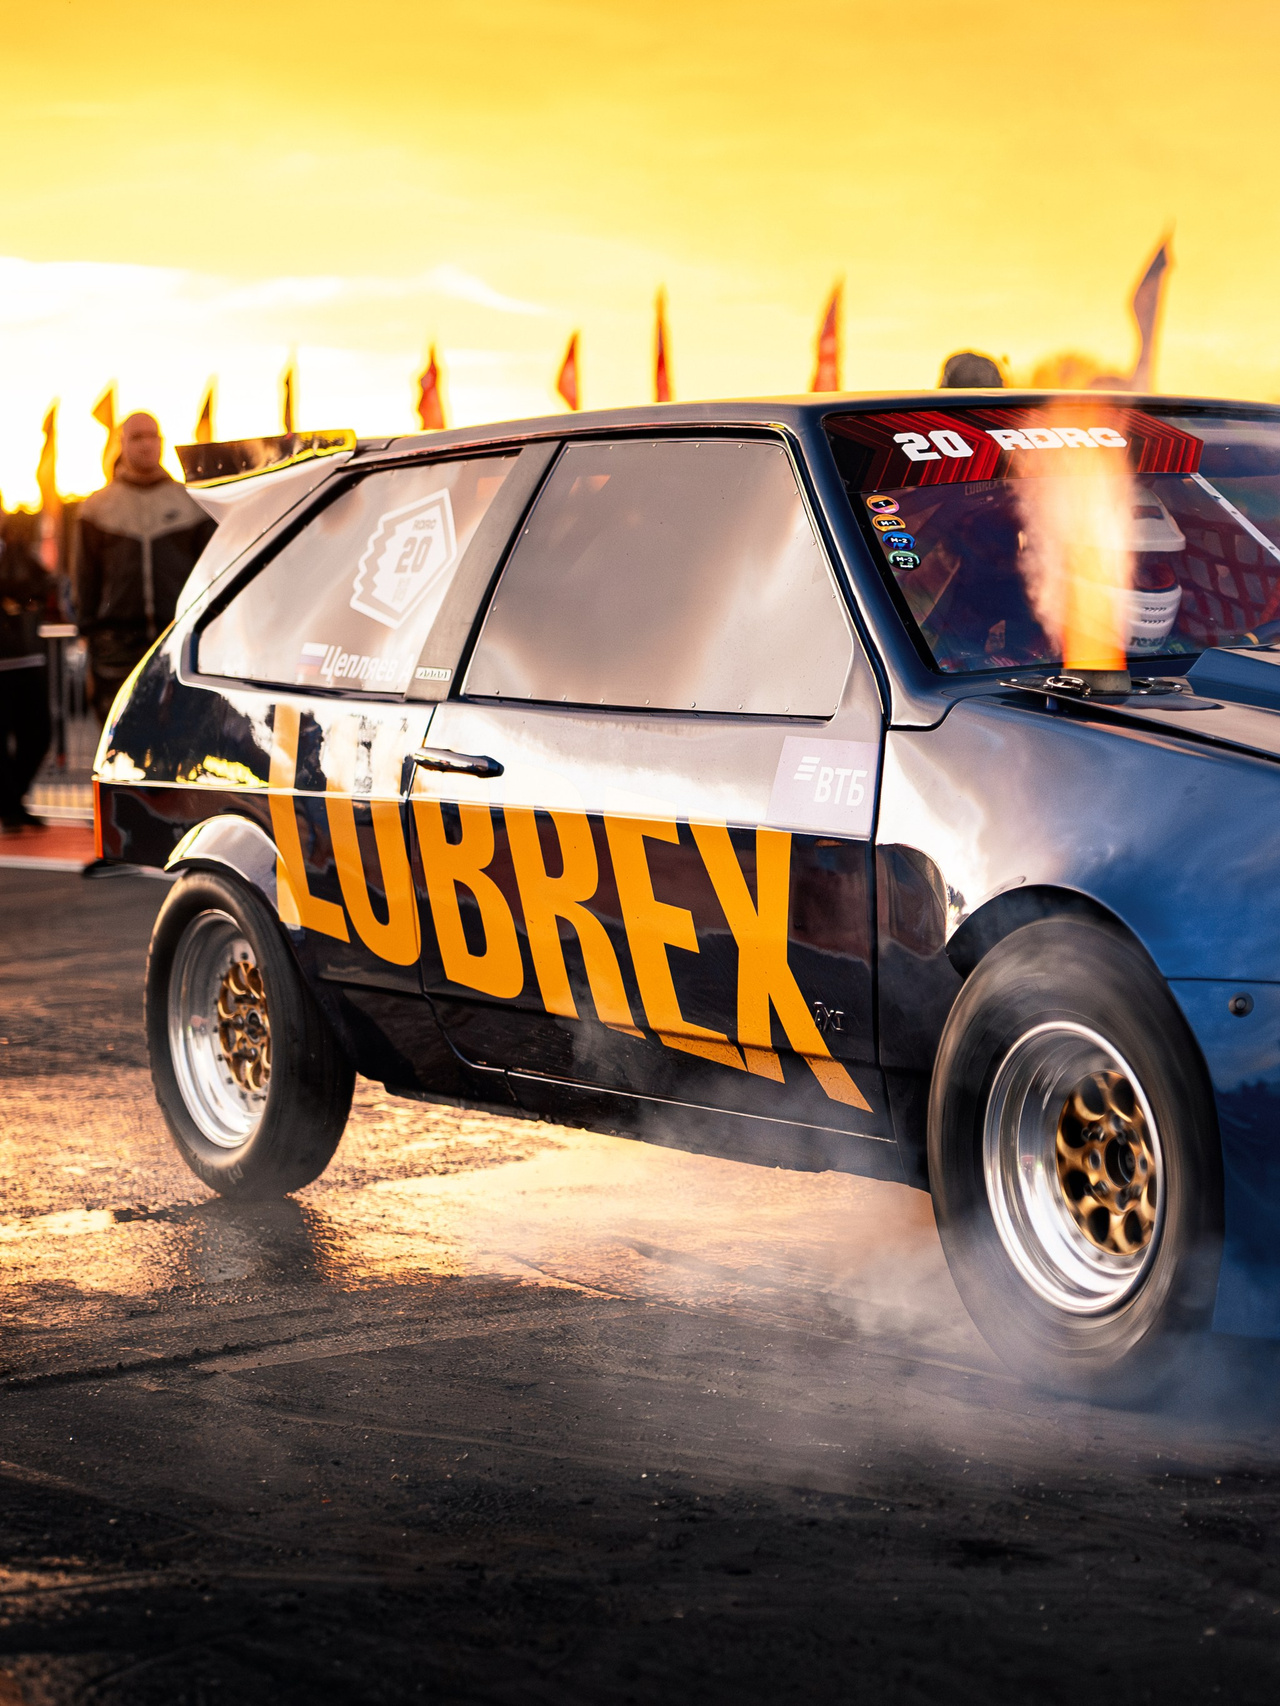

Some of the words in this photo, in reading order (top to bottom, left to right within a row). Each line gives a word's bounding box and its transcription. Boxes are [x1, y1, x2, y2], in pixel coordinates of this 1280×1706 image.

[893, 430, 974, 461] 20
[985, 427, 1128, 450] RDRC
[394, 536, 433, 574] 20
[815, 767, 867, 808] ВТБ
[266, 703, 873, 1114] LUBREX
